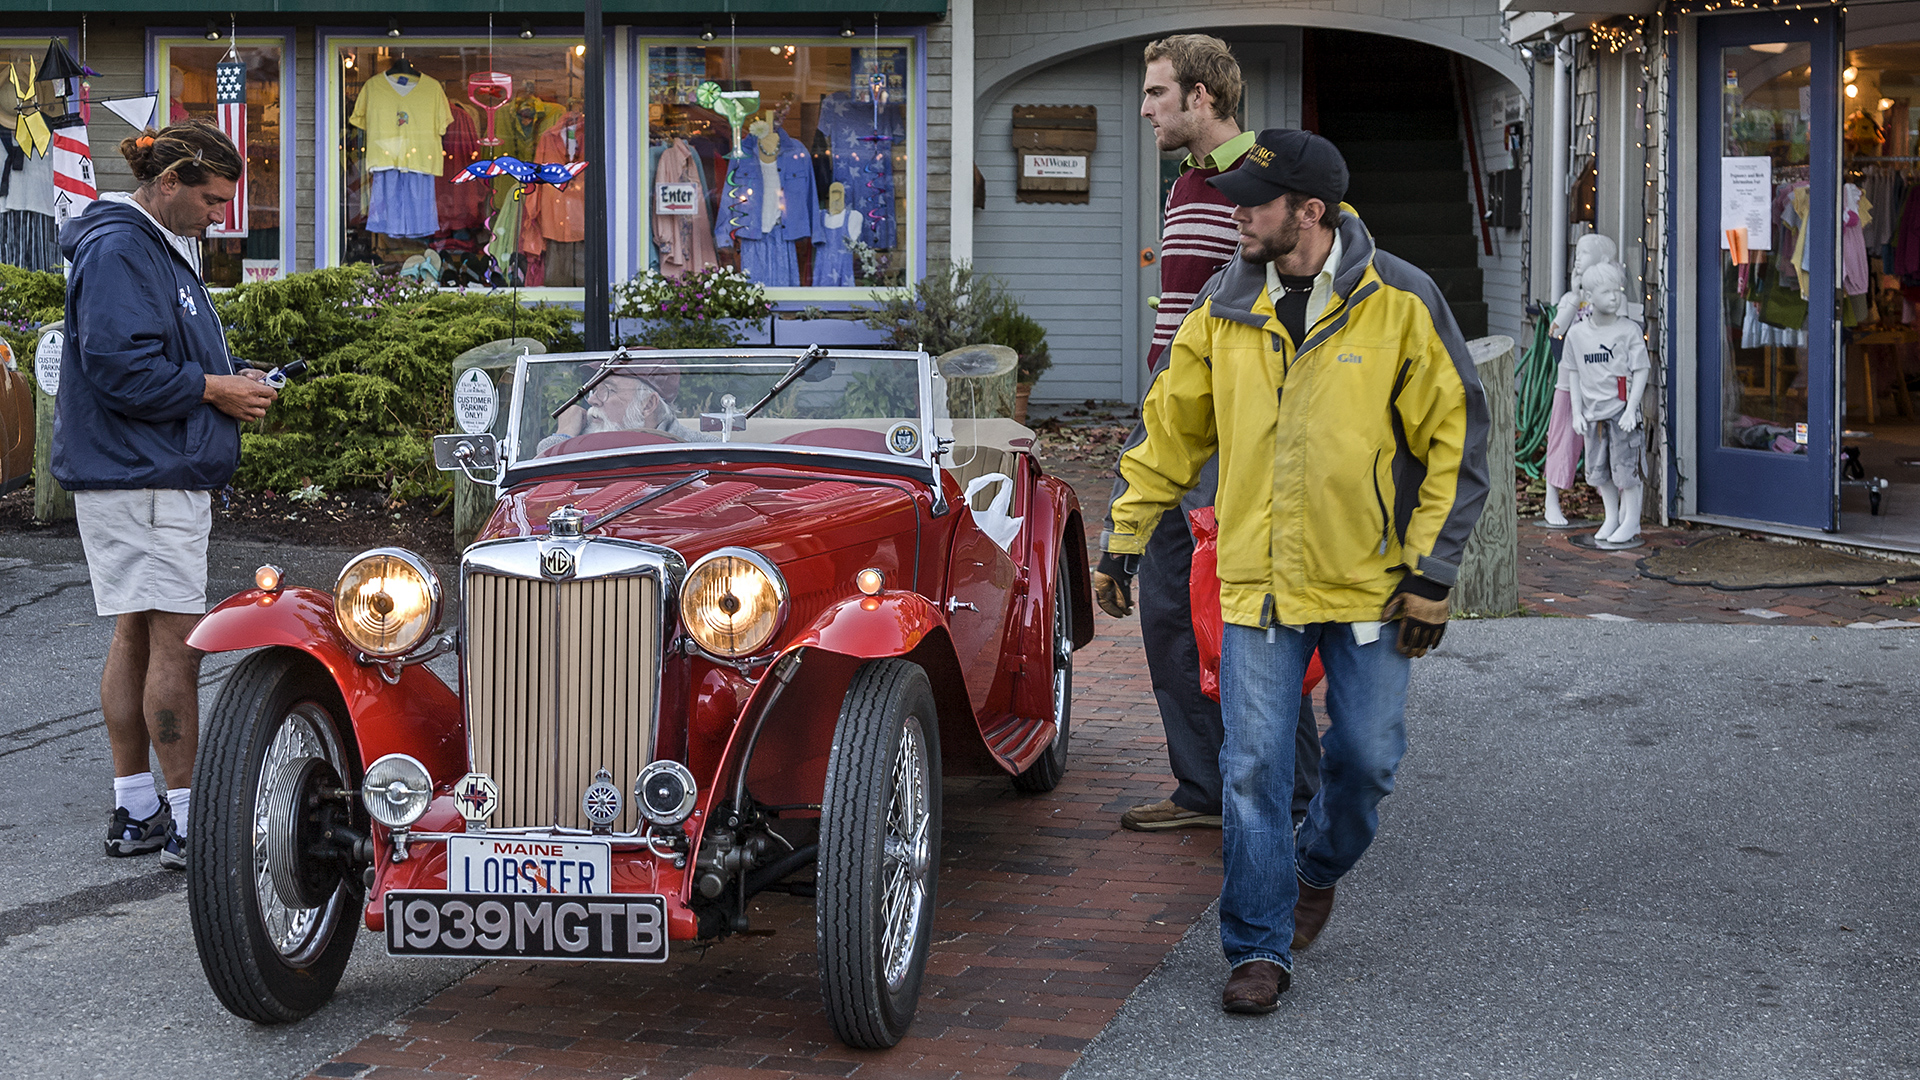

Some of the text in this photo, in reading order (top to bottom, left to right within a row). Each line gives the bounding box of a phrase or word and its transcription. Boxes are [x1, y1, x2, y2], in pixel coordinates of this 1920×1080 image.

[660, 185, 693, 203] Enter
[1336, 352, 1363, 363] Gill
[1583, 352, 1609, 364] PUMA
[457, 396, 492, 404] CUSTOMER
[460, 404, 488, 412] PARKING
[547, 550, 568, 571] MG
[493, 842, 563, 857] MAINE
[464, 856, 595, 894] LOBSTER
